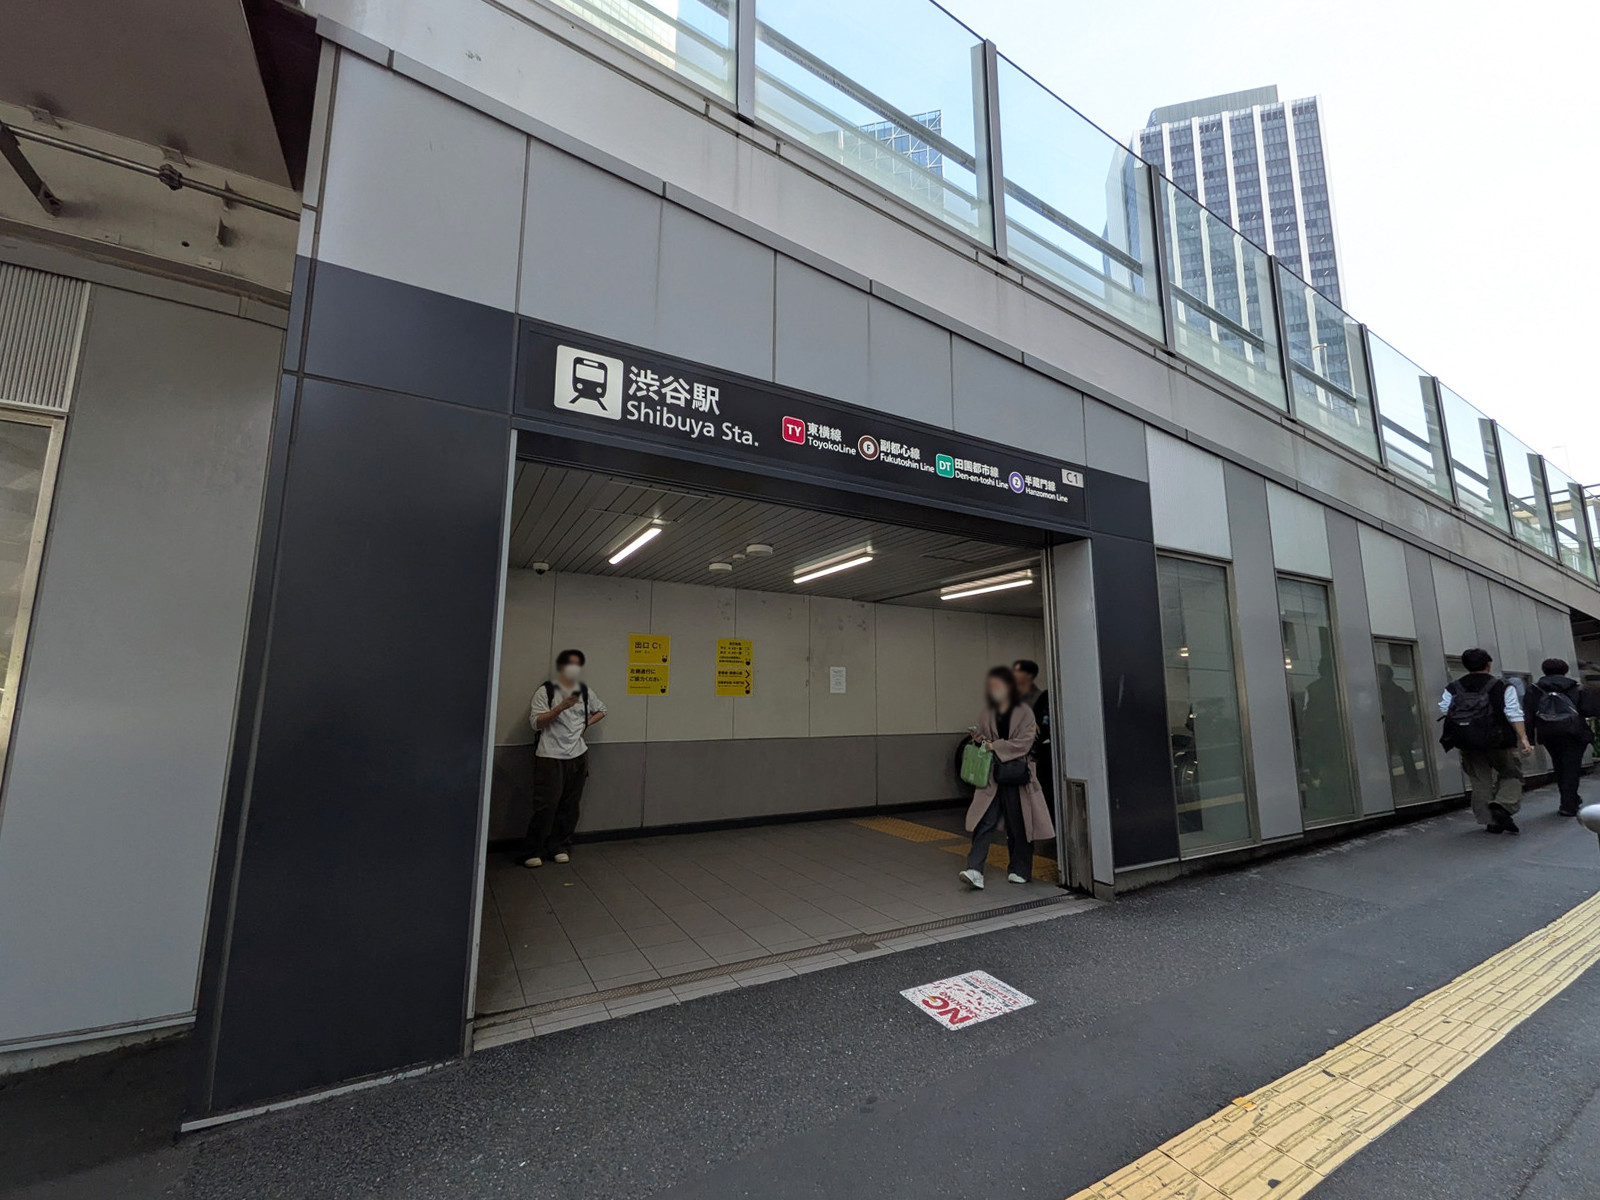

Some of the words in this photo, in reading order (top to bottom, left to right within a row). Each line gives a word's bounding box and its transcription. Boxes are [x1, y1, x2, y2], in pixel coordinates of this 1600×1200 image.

[628, 365, 720, 416] 渋谷駅
[626, 400, 715, 439] Shibuya
[721, 421, 759, 447] Sta.
[786, 423, 802, 437] TY
[807, 422, 842, 442] 東横線
[880, 438, 921, 460] 副都心線
[880, 452, 919, 470] Fukutoshin
[919, 462, 935, 473] Line
[938, 460, 951, 472] DT
[954, 458, 999, 478] 田園都市線
[955, 470, 995, 487] Den-en-toshi
[995, 479, 1009, 490] Line
[1025, 475, 1057, 492] 半蔵門線
[1066, 472, 1079, 485] C1
[1025, 487, 1056, 501] Hanzomon
[1056, 493, 1069, 504] Line
[634, 641, 650, 649] 出口
